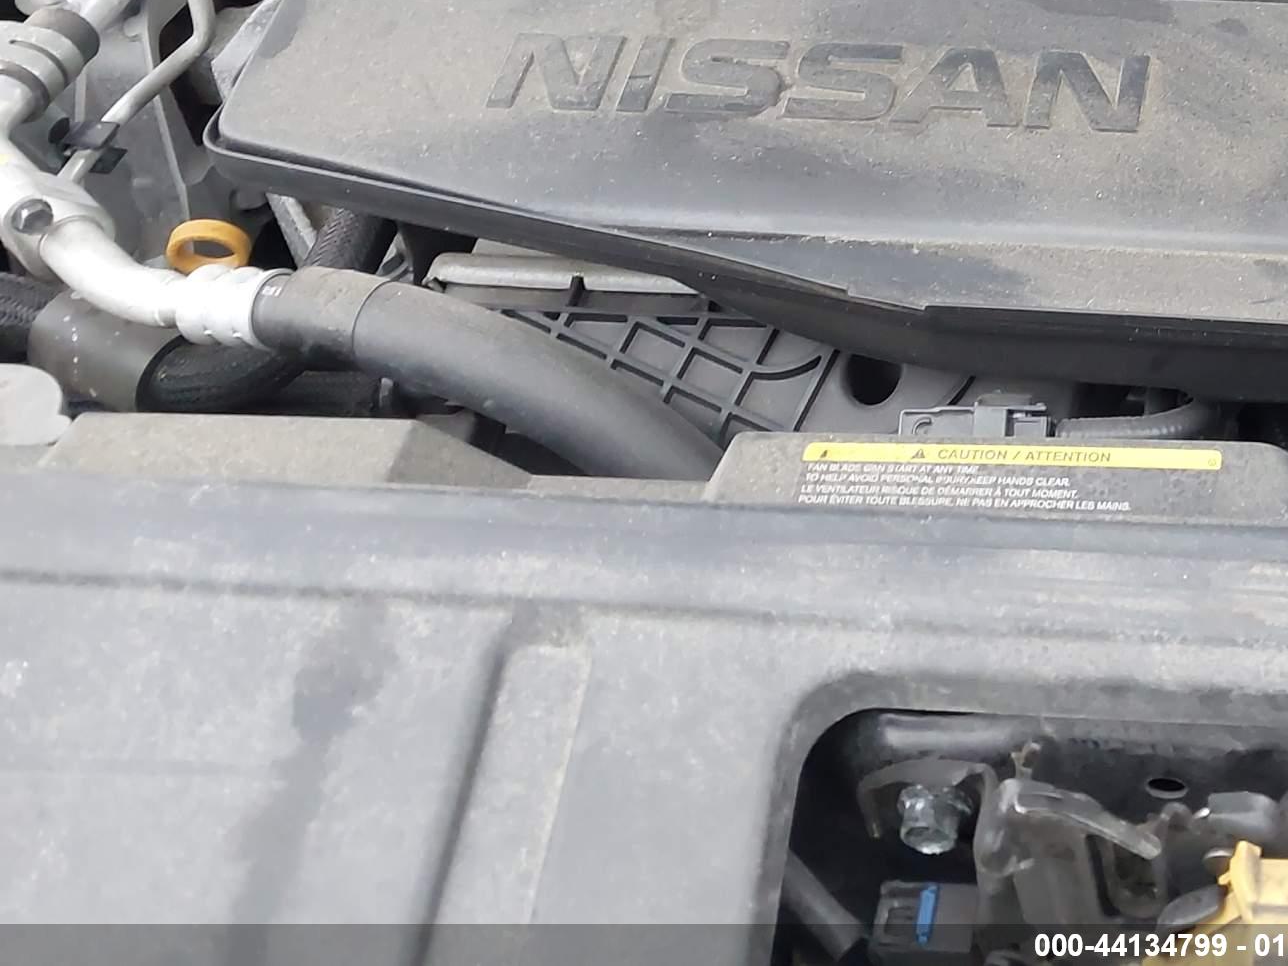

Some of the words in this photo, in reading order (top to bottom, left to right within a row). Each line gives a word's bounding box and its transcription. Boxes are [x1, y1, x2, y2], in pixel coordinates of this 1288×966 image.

[486, 33, 1151, 134] NISSAN
[937, 449, 1008, 460] CAUTION
[1012, 450, 1020, 461] /
[1025, 451, 1111, 463] ATTENTION
[997, 476, 1034, 486] HANDS
[801, 484, 812, 493] LE
[920, 486, 936, 495] DE
[1004, 488, 1030, 497] TOUT
[866, 495, 898, 505] TOUTE
[971, 497, 993, 507] PAS
[994, 498, 1009, 507] EN
[1009, 498, 1075, 510] APPROCHER
[1075, 500, 1095, 510] LES
